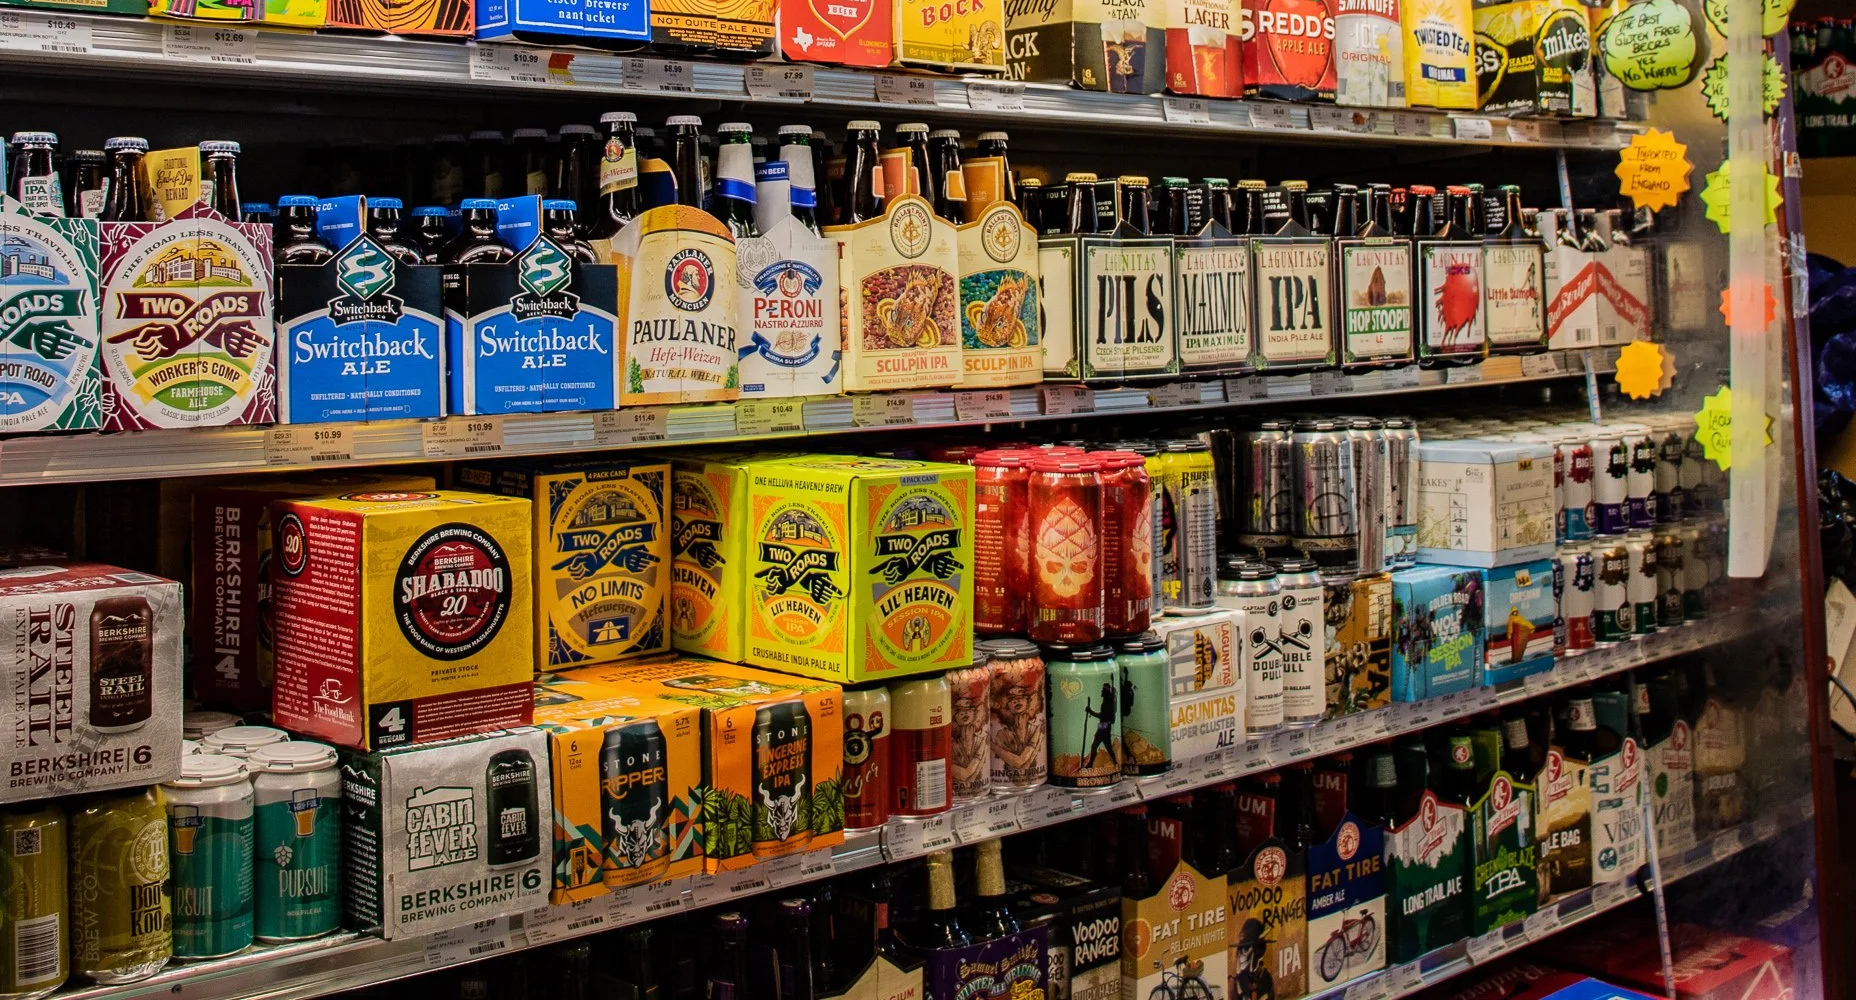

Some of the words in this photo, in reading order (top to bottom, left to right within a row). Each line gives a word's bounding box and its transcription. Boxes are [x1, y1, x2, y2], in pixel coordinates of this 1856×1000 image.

[48, 20, 76, 30] $10.49
[558, 8, 616, 24] nantucket
[832, 6, 854, 17] BEER
[1184, 6, 1230, 30] LAGER
[1638, 13, 1662, 26] BEST
[215, 33, 244, 43] $12.69
[657, 16, 680, 26] NOT
[685, 19, 717, 30] QUITE
[720, 23, 747, 33] PALE
[749, 26, 771, 35] ALE
[1258, 11, 1336, 40] REDD'S
[1653, 24, 1680, 37] FREE
[513, 53, 539, 64] $10.99
[1542, 30, 1591, 61] mike's
[1636, 57, 1656, 71] YES
[754, 297, 822, 318] PERONI
[1096, 274, 1164, 344] PILS
[1182, 271, 1247, 336] MAXIMUS
[1269, 274, 1322, 331] IPA
[140, 298, 186, 316] TWO
[186, 297, 249, 338] ROADS
[754, 319, 789, 328] NASTRO
[790, 319, 824, 328] AZZURRO
[1350, 311, 1372, 333] HOP
[1372, 307, 1409, 331] STOOPID
[294, 328, 434, 365] Switchback
[632, 318, 737, 353] PAULANER
[341, 360, 391, 376] ALE
[649, 346, 721, 366] Hefe-Weizen
[877, 356, 928, 373] SCULPIN
[930, 355, 948, 369] IPA
[148, 362, 209, 388] WORKER'S
[211, 361, 241, 384] COMP
[434, 555, 474, 566] BERKSHIRE
[888, 538, 912, 550] TWO
[910, 534, 949, 566] ROADS
[226, 507, 240, 648] BERKSHIRE
[401, 567, 504, 604] SHABADOO
[440, 596, 467, 616] 20
[571, 586, 597, 609] NO
[600, 580, 643, 601] LIMITS
[905, 586, 954, 610] HEAVEN
[54, 602, 76, 745] STEEL
[431, 666, 457, 676] PRIVATE
[458, 664, 478, 673] STOCK
[752, 647, 789, 663] CRUSHABLE
[790, 653, 809, 668] INDIA
[810, 659, 826, 670] PALE
[827, 662, 840, 673] ALE
[29, 605, 52, 748] RAIL
[10, 749, 125, 778] BERKSHIRE
[133, 745, 152, 767] 6
[603, 750, 661, 772] STONE
[9, 772, 65, 789] BREWING
[68, 765, 124, 782] COMPANY
[601, 766, 666, 800] RIPPER
[406, 802, 474, 834] CABIN
[408, 826, 475, 858] FEVER
[279, 864, 328, 898] PURSUIT
[1311, 870, 1339, 892] FAT
[1348, 855, 1381, 877] TIRE
[1403, 891, 1424, 916] LONG
[1424, 885, 1446, 908] TRAIL
[1446, 876, 1463, 896] ALE
[1072, 917, 1119, 944] VOODOO
[1152, 919, 1181, 943] FAT
[1188, 906, 1225, 930] TIRE
[1074, 935, 1119, 966] RANGER
